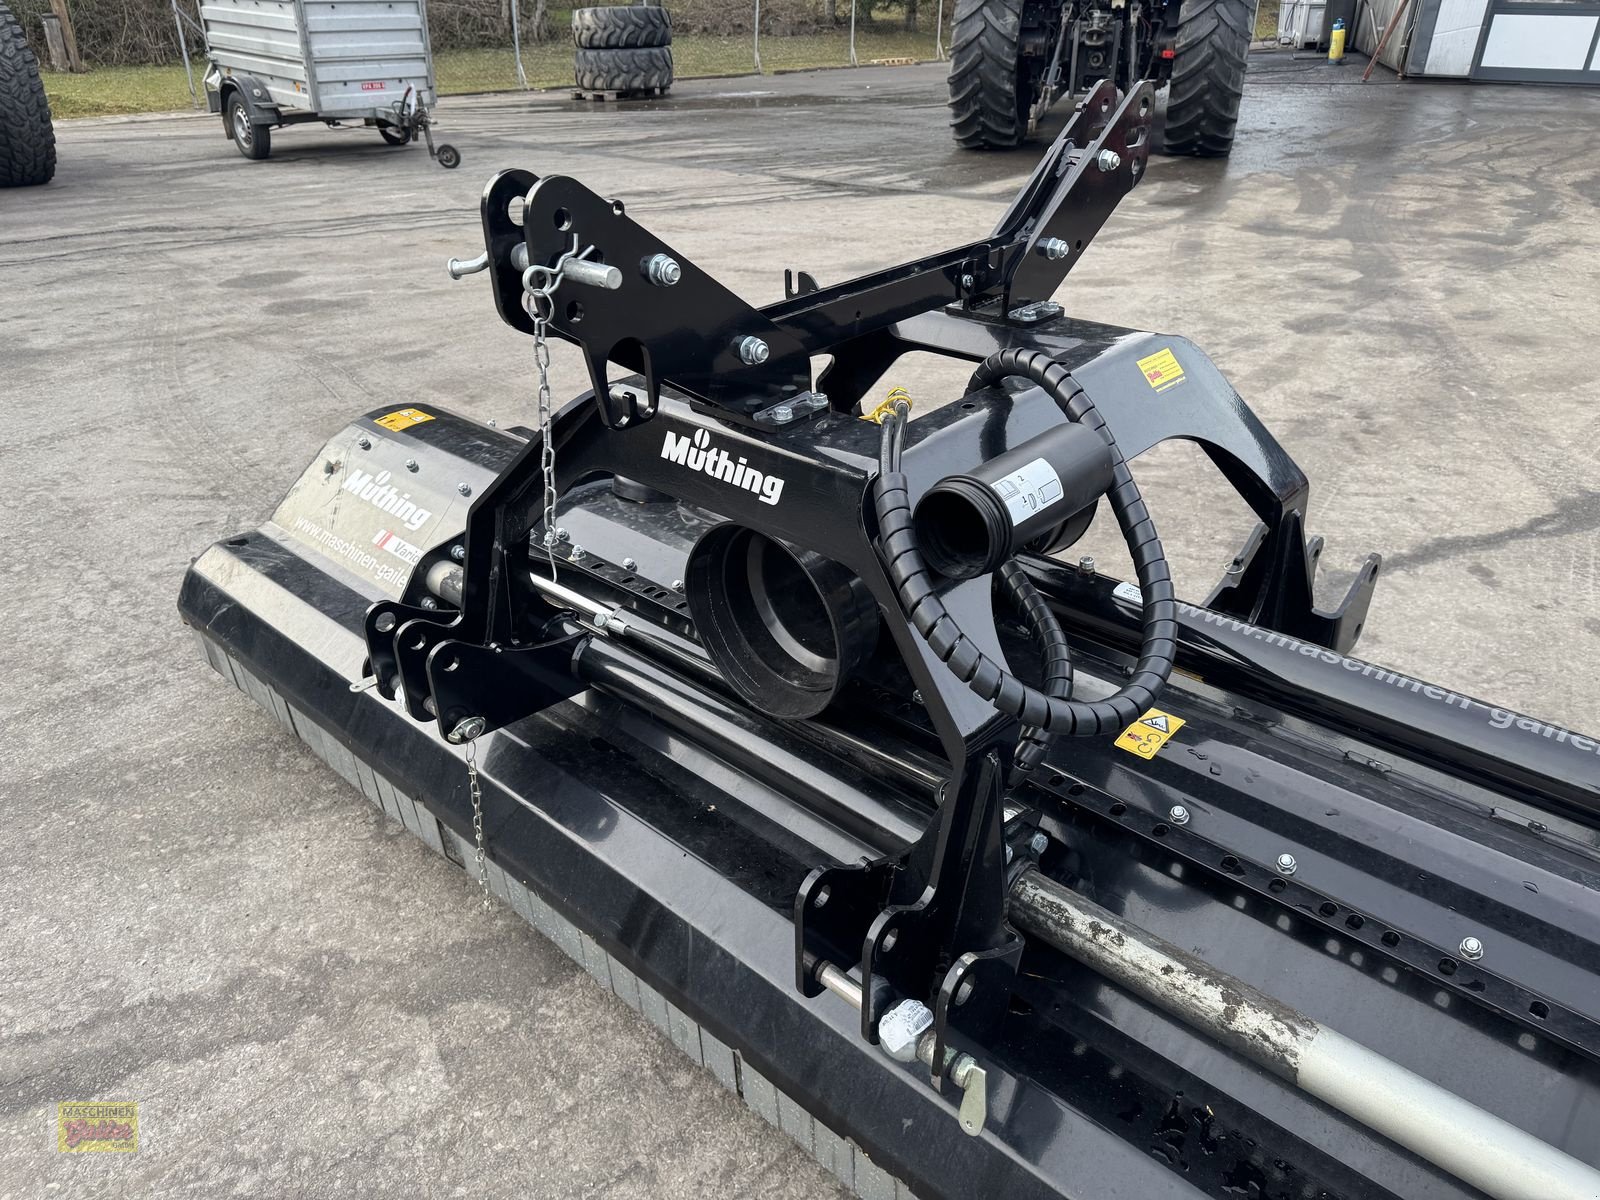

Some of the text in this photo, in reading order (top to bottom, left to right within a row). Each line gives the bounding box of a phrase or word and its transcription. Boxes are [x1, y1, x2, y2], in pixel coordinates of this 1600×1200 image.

[342, 469, 432, 531] Müthing
[660, 428, 785, 506] Müthing
[294, 516, 407, 588] www.maschinen-gaile
